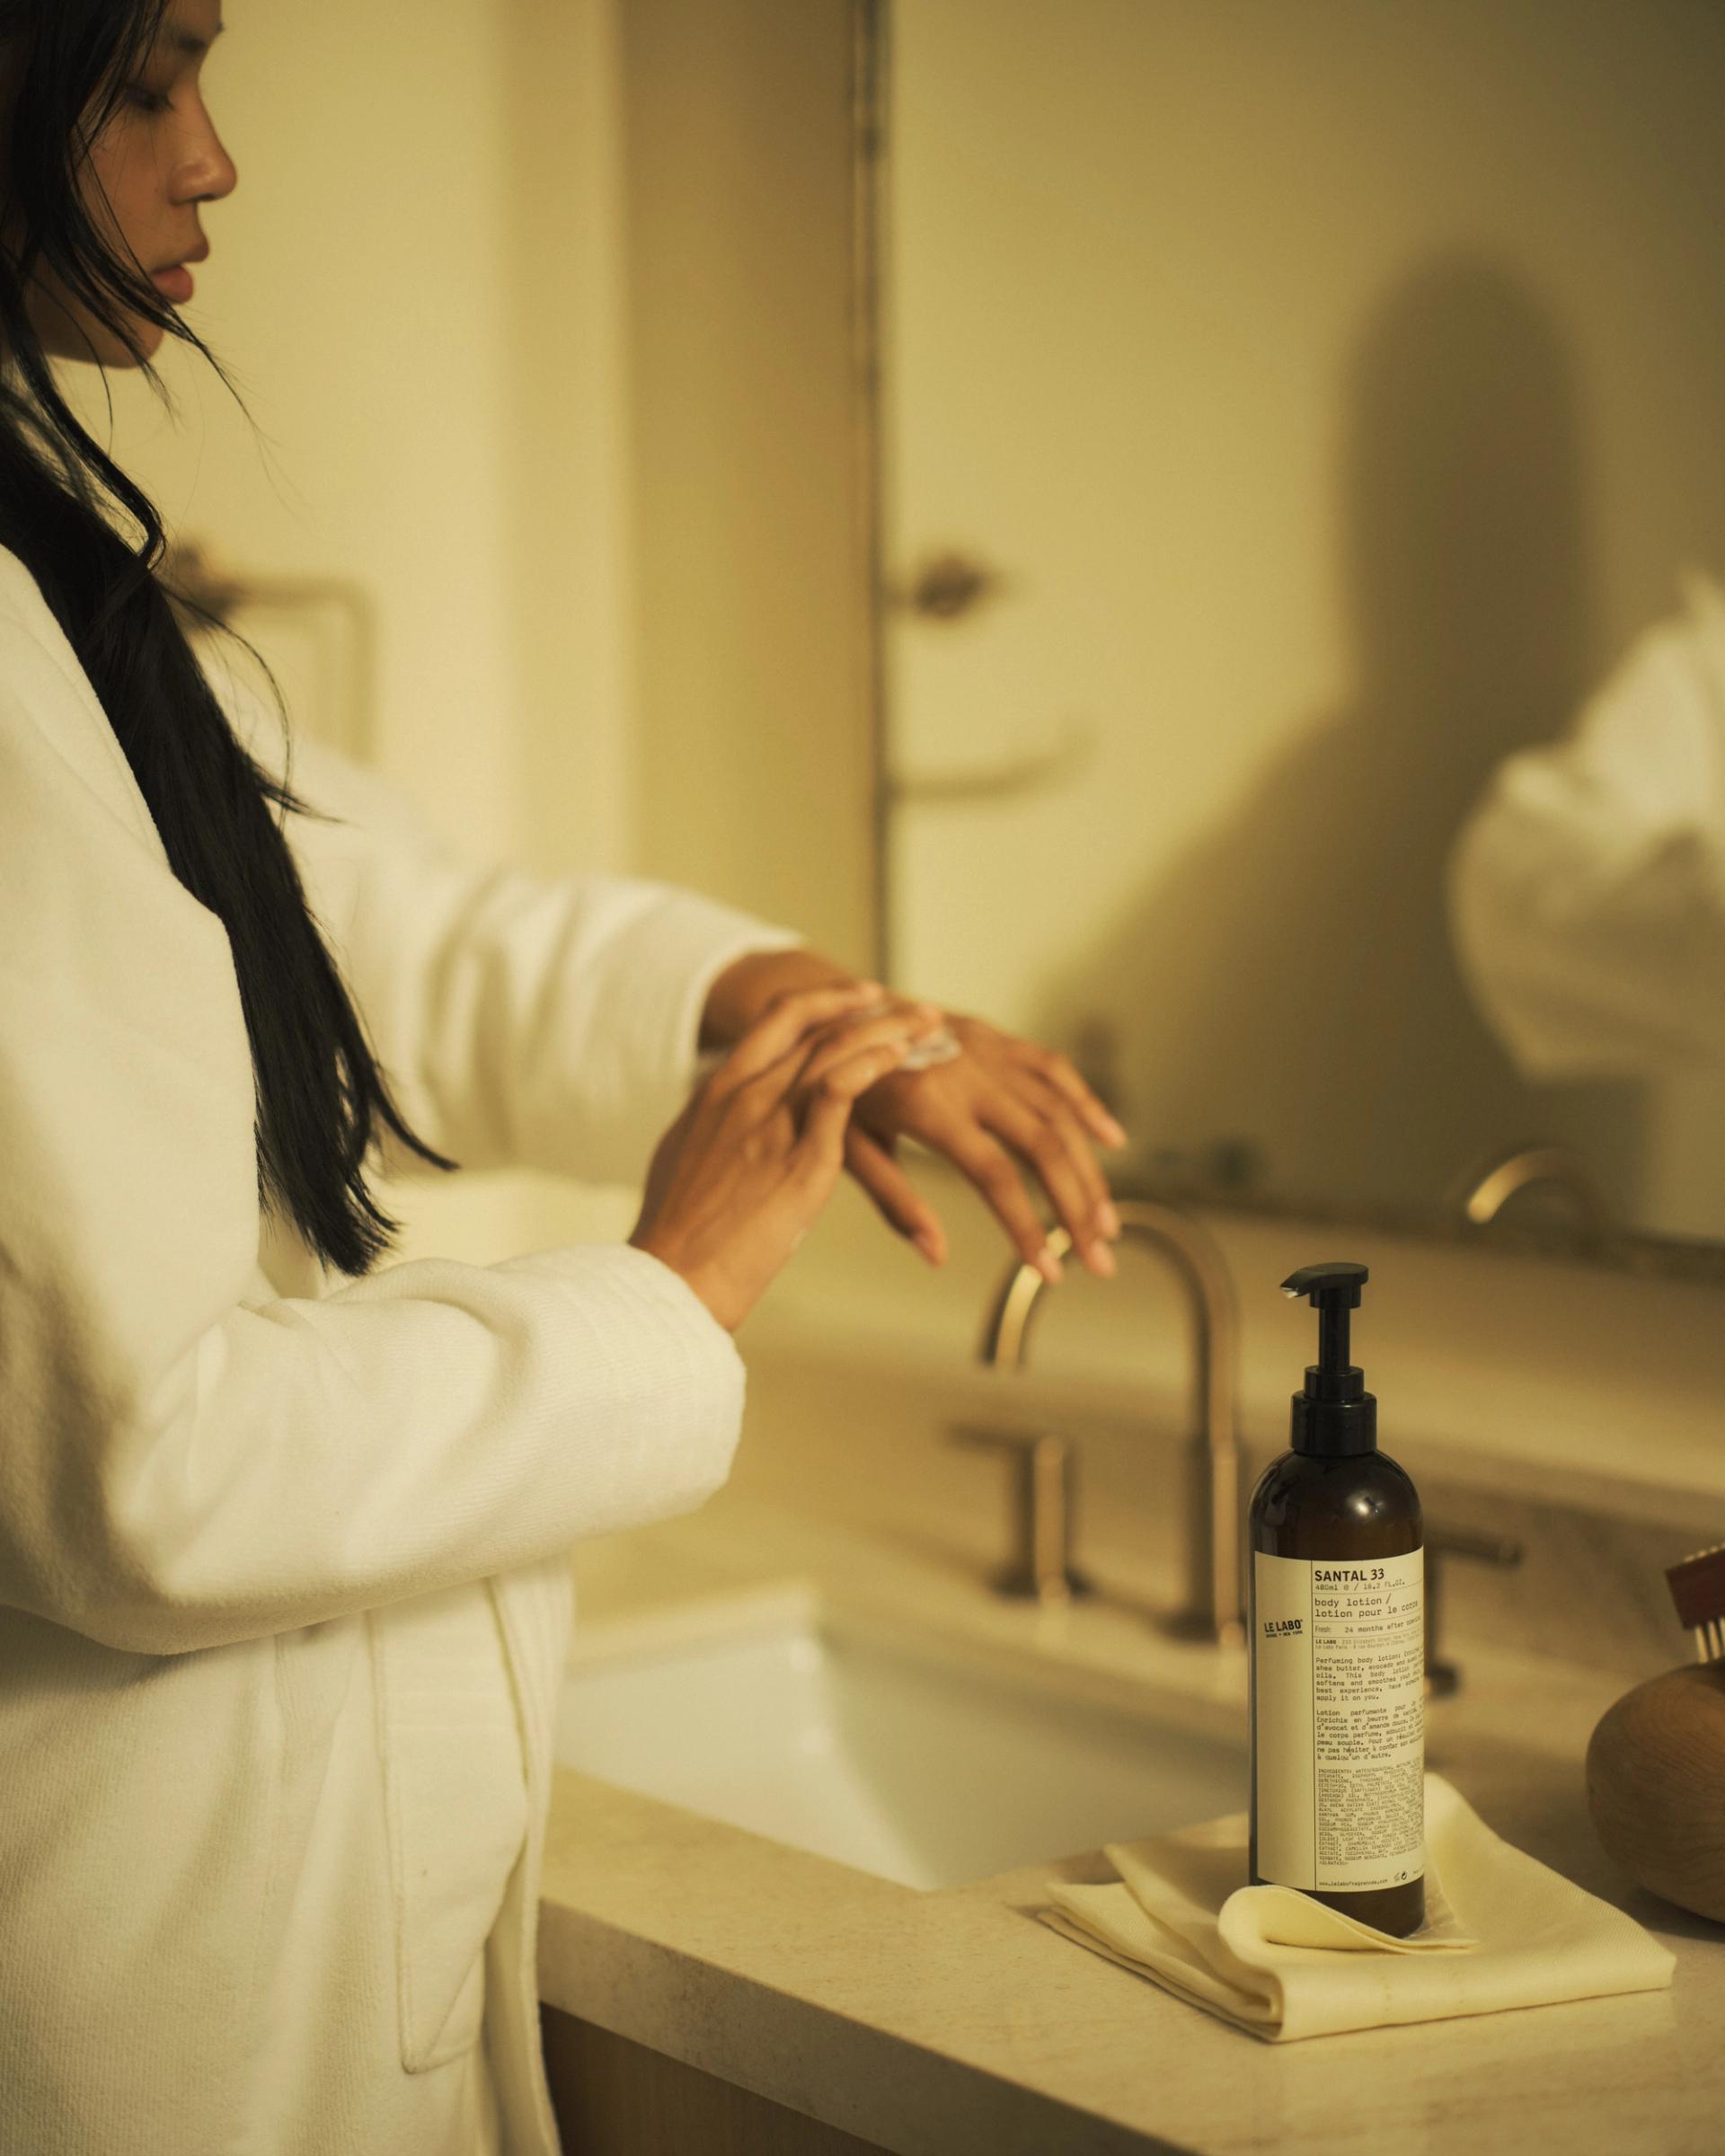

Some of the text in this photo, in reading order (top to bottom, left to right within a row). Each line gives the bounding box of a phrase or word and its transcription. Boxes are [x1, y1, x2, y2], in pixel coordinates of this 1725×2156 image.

[1314, 1568, 1384, 1582] SANTAL 33
[1314, 1598, 1340, 1608] body
[1347, 1597, 1382, 1606] lotion
[1314, 1608, 1352, 1618] lotion
[1358, 1609, 1382, 1619] pour
[1387, 1605, 1397, 1614] le
[1263, 1622, 1275, 1633] LE
[1315, 1657, 1353, 1665] Perfuming
